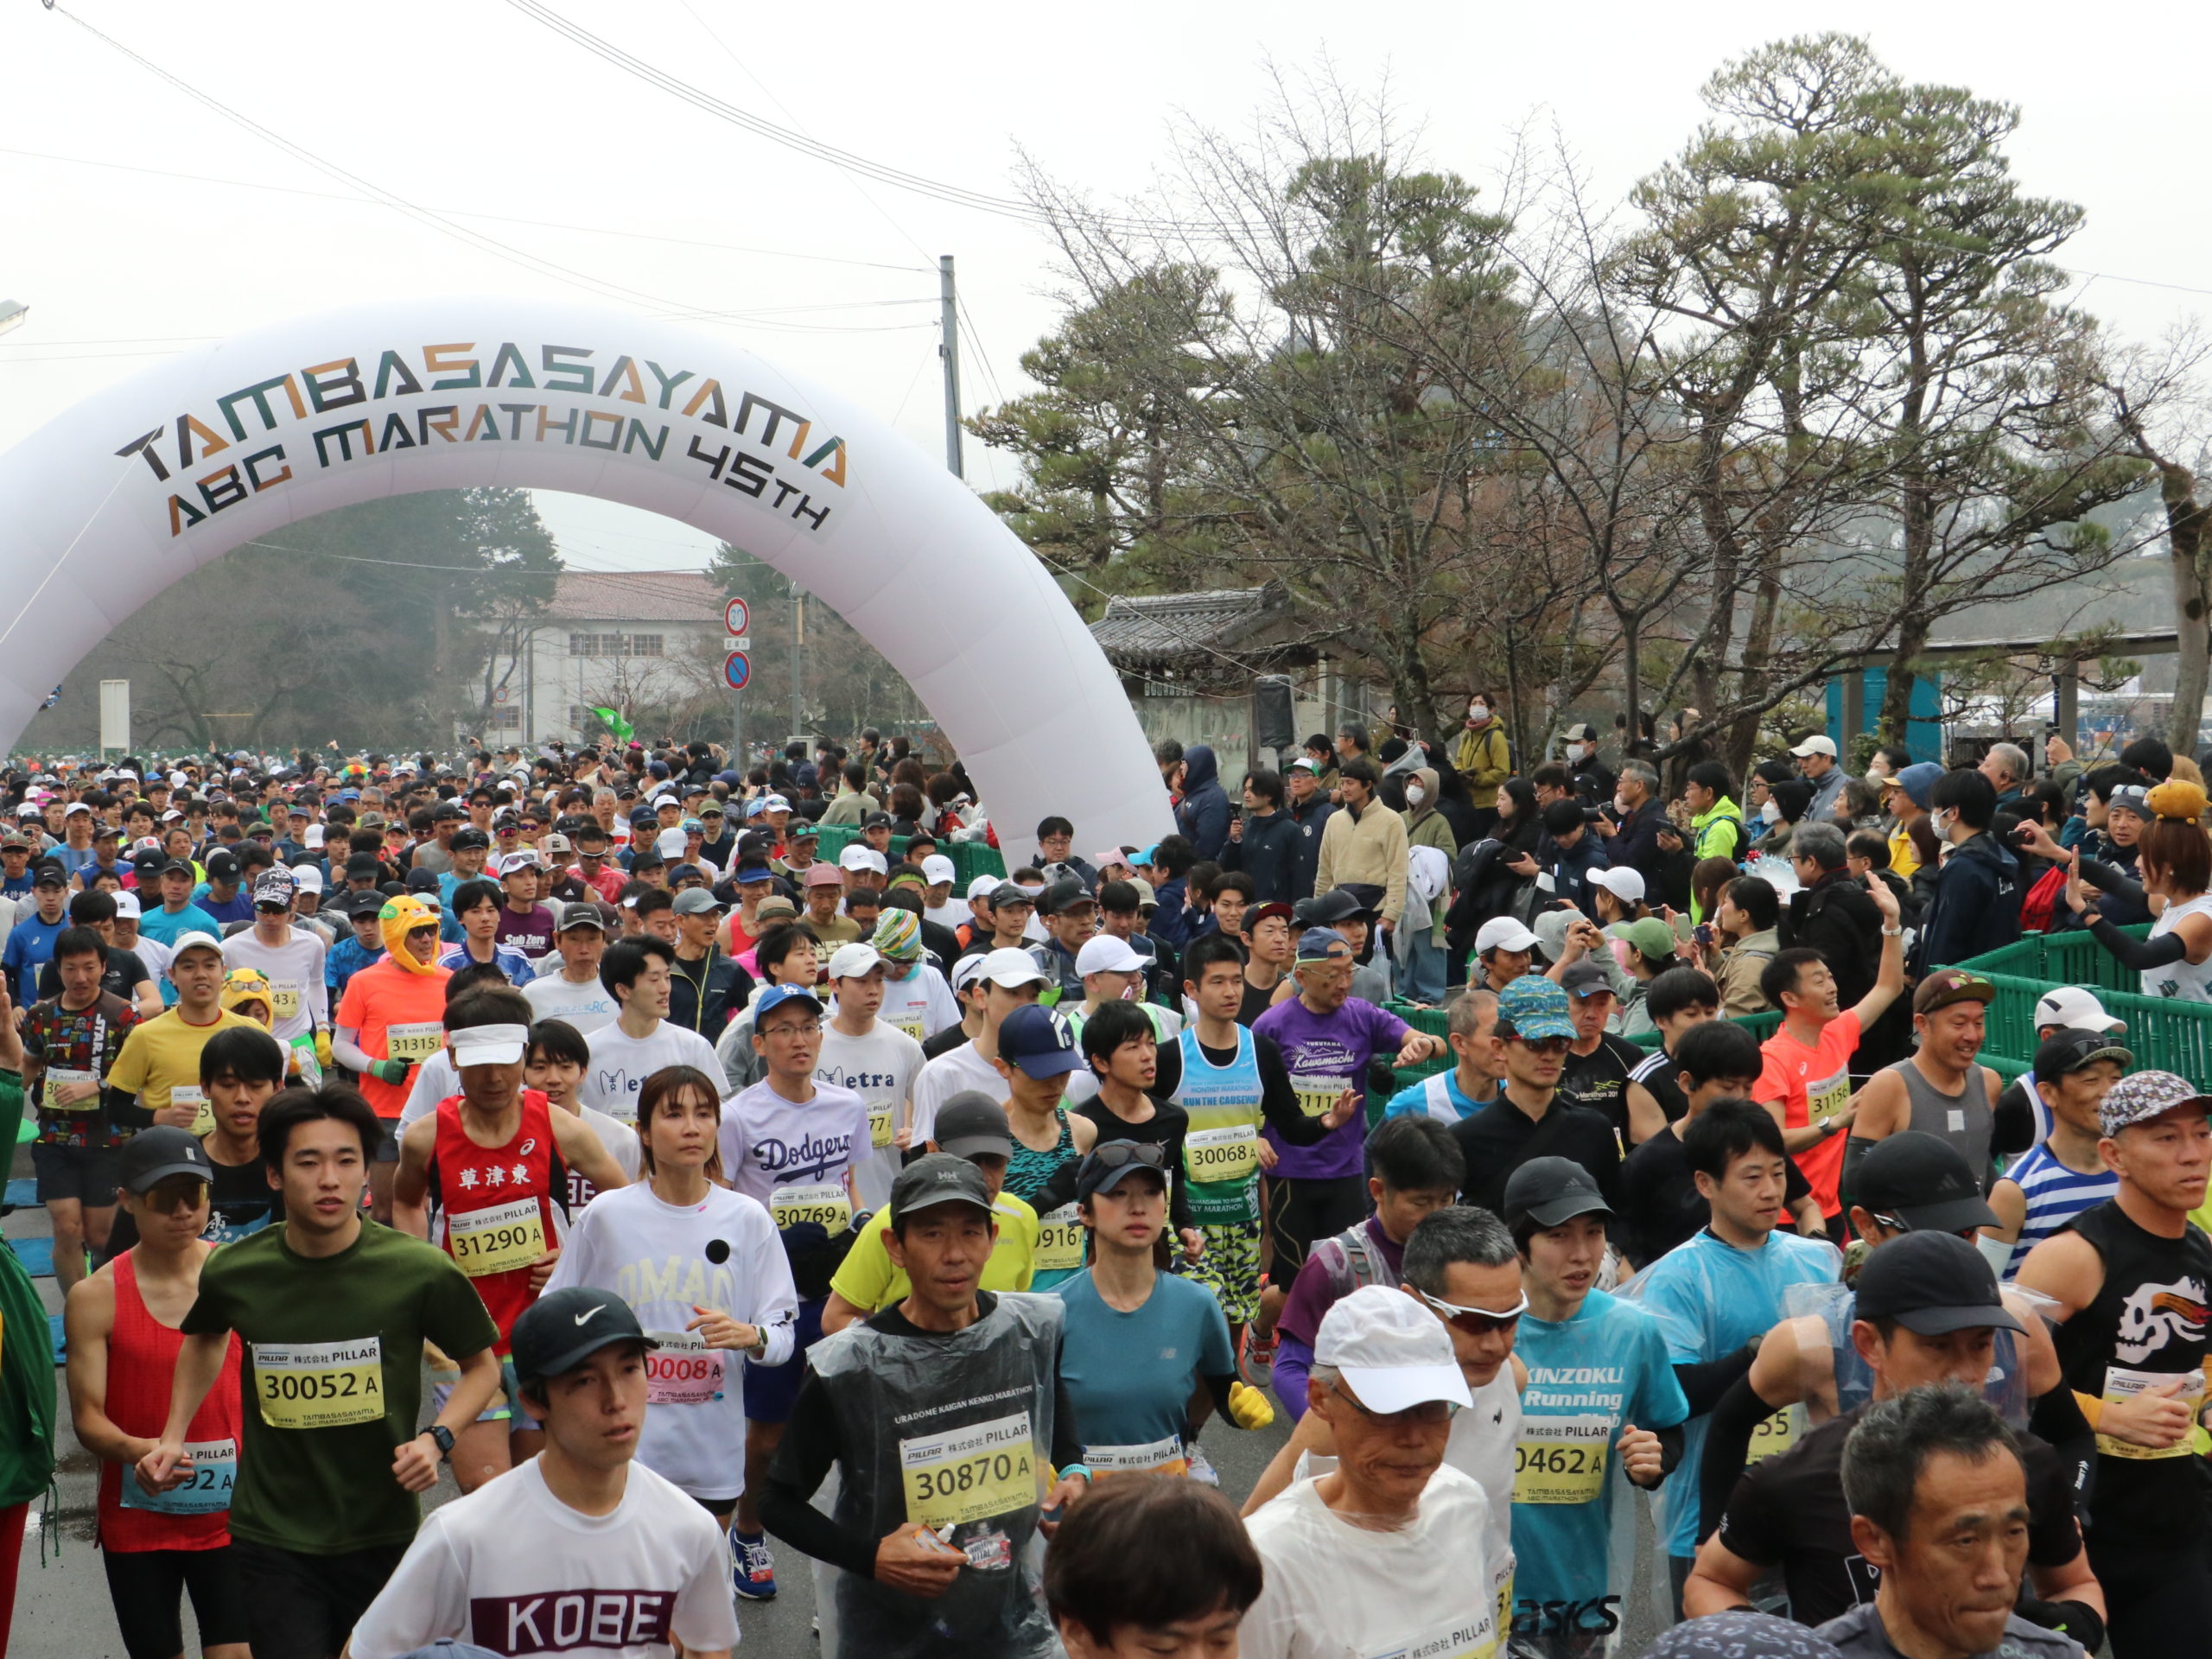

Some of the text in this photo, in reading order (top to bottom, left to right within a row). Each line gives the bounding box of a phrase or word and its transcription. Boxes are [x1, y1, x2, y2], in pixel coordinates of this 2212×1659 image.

[114, 342, 847, 489] TAMBASASAYAMA
[172, 403, 830, 537] ABC MARATHON 45TH
[730, 608, 744, 626] 30
[505, 934, 546, 945] Sub Zero
[92, 1013, 106, 1055] STAR
[392, 1037, 435, 1052] 31315
[1294, 1049, 1356, 1069] Kawamachi
[1183, 1096, 1201, 1107] RUN
[1202, 1096, 1217, 1106] THE
[1813, 1084, 1847, 1113] 31156
[1233, 1129, 1254, 1139] PILLAR
[753, 1132, 850, 1181] Dodgers
[1193, 1145, 1256, 1166] 30068 A
[458, 1163, 531, 1191] 草津東
[820, 1190, 846, 1199] PILLAR
[504, 1205, 537, 1220] PILLAR
[777, 1206, 847, 1227] 30769 A
[455, 1226, 541, 1256] 31290 A
[294, 1355, 329, 1364] 株式会社
[333, 1347, 377, 1363] PILLAR
[711, 1363, 721, 1378] A
[264, 1372, 378, 1400] 30052 A
[2111, 1380, 2146, 1389] PILLAR
[894, 1384, 1033, 1425] URADOME KAIGAN KENKO MARATHON
[1523, 1390, 1624, 1411] Running
[302, 1408, 375, 1421] TAMBASASAYAMA
[907, 1423, 1028, 1460] PILLAR 株式会社 PILLAR
[1526, 1427, 1608, 1437] 株式会社 PILLAR
[196, 1447, 234, 1459] PILLAR
[1119, 1455, 1151, 1465] 株式会社
[1153, 1445, 1180, 1462] PILLAR
[1591, 1456, 1602, 1474] A
[220, 1474, 232, 1490] A
[915, 1453, 1030, 1500] 30870 A
[507, 1595, 662, 1652] KOBE
[1452, 1618, 1491, 1646] PILLAR
